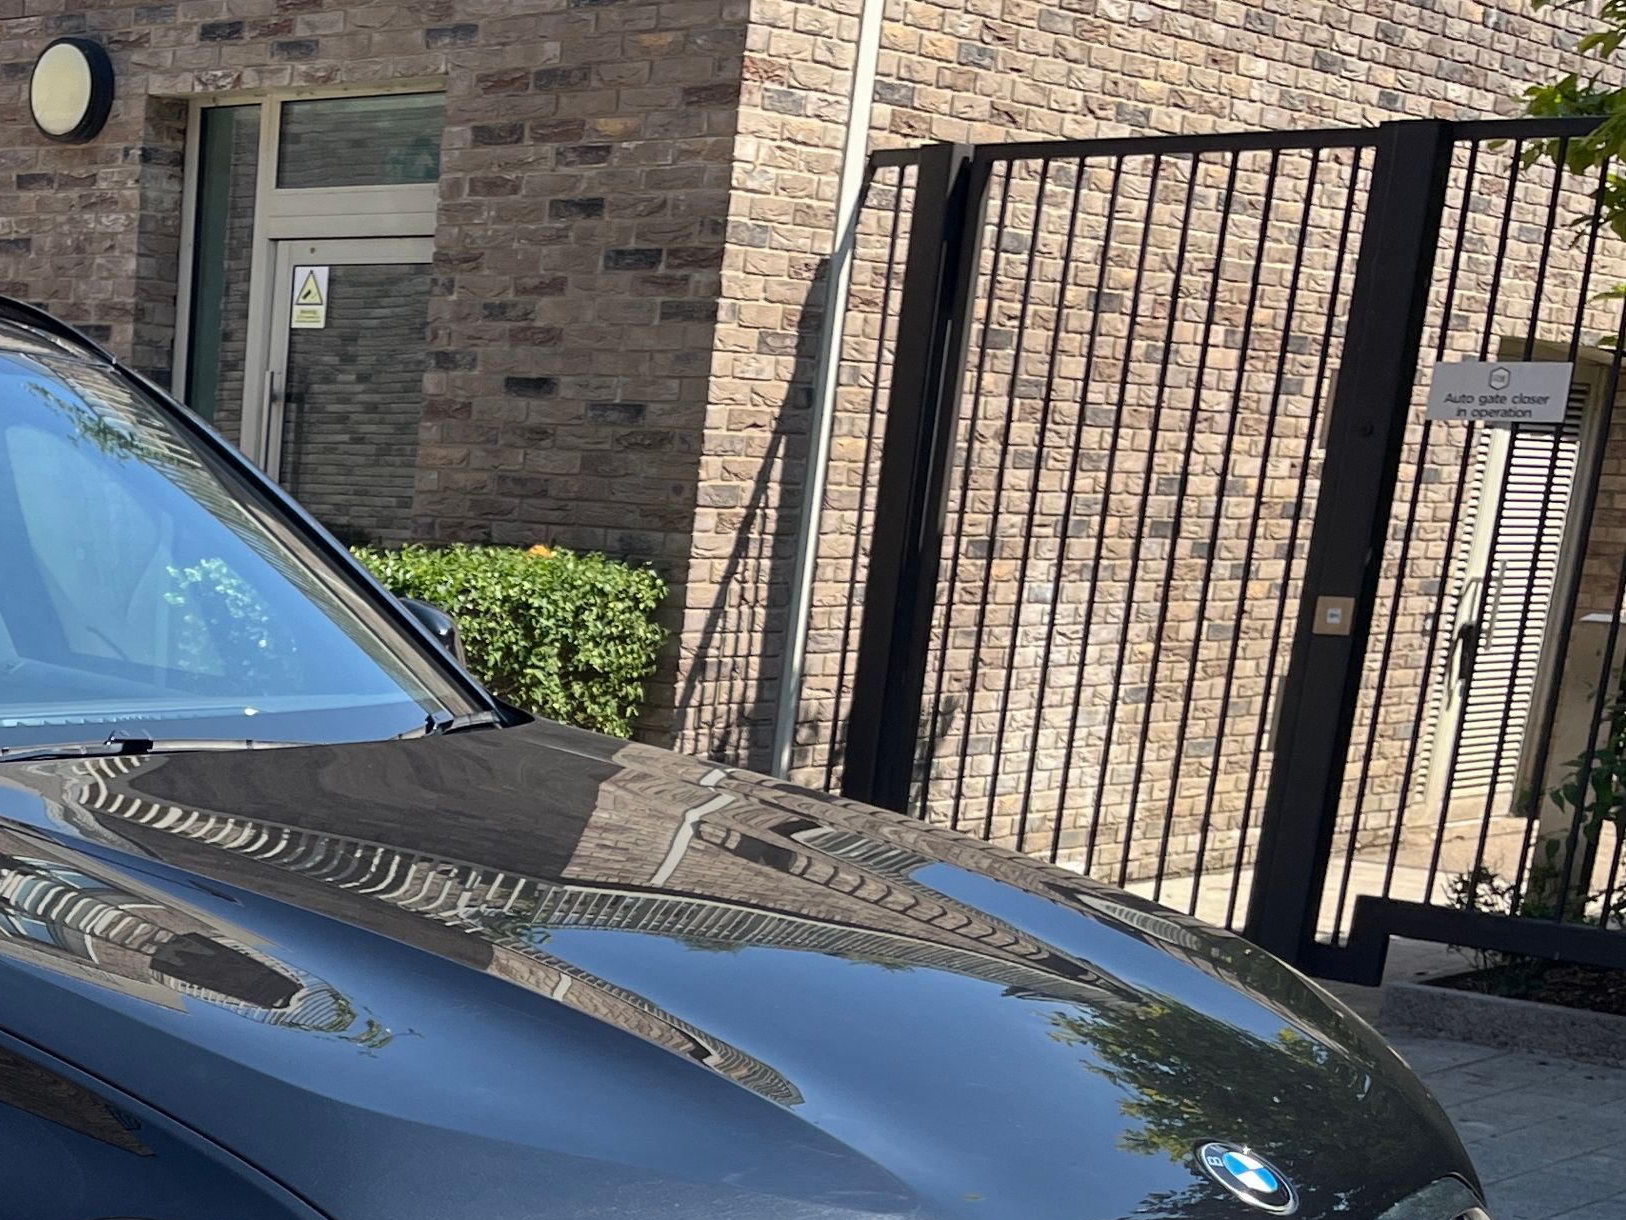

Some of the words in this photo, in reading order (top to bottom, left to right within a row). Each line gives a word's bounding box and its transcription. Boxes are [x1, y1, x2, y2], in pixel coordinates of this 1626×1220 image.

[1444, 392, 1475, 405] Auto
[1478, 393, 1506, 406] gate
[1511, 392, 1551, 405] closer
[1456, 406, 1467, 417] in
[1471, 406, 1532, 419] operation
